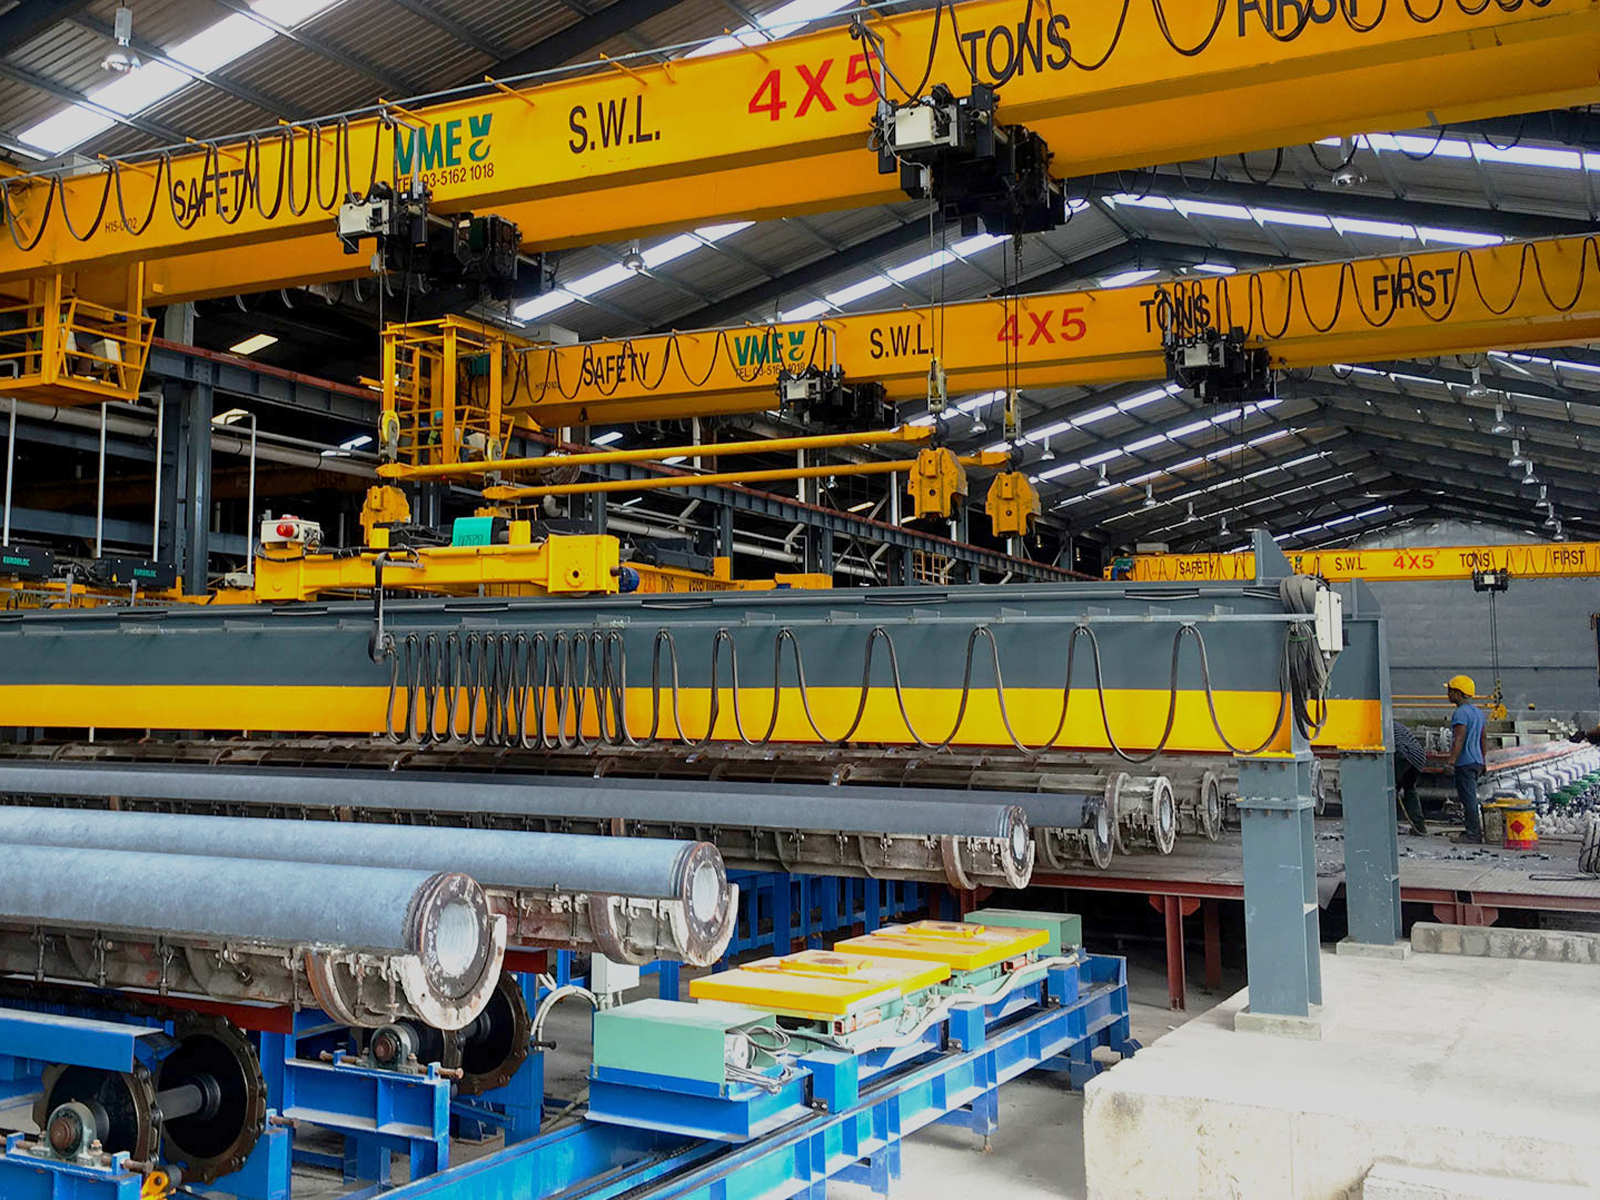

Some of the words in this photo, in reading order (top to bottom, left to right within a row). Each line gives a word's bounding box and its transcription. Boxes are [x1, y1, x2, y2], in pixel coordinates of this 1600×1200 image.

[568, 95, 661, 153] S.W.L.
[748, 51, 882, 121] 4X5
[961, 14, 1072, 82] TONS
[396, 119, 462, 176] VME
[470, 162, 495, 180] 1018
[173, 168, 258, 222] SAFETY
[1373, 268, 1454, 311] FIRST
[734, 331, 783, 366] VME
[870, 323, 934, 359] S.W.L.
[997, 306, 1087, 347] 4X5
[583, 352, 649, 386] SAFETY
[1179, 560, 1214, 575] SAFETY
[1335, 557, 1367, 571] S.W.L.
[1393, 554, 1434, 569] 4X5
[1459, 552, 1490, 568] TONS
[1553, 550, 1585, 565] FIRST
